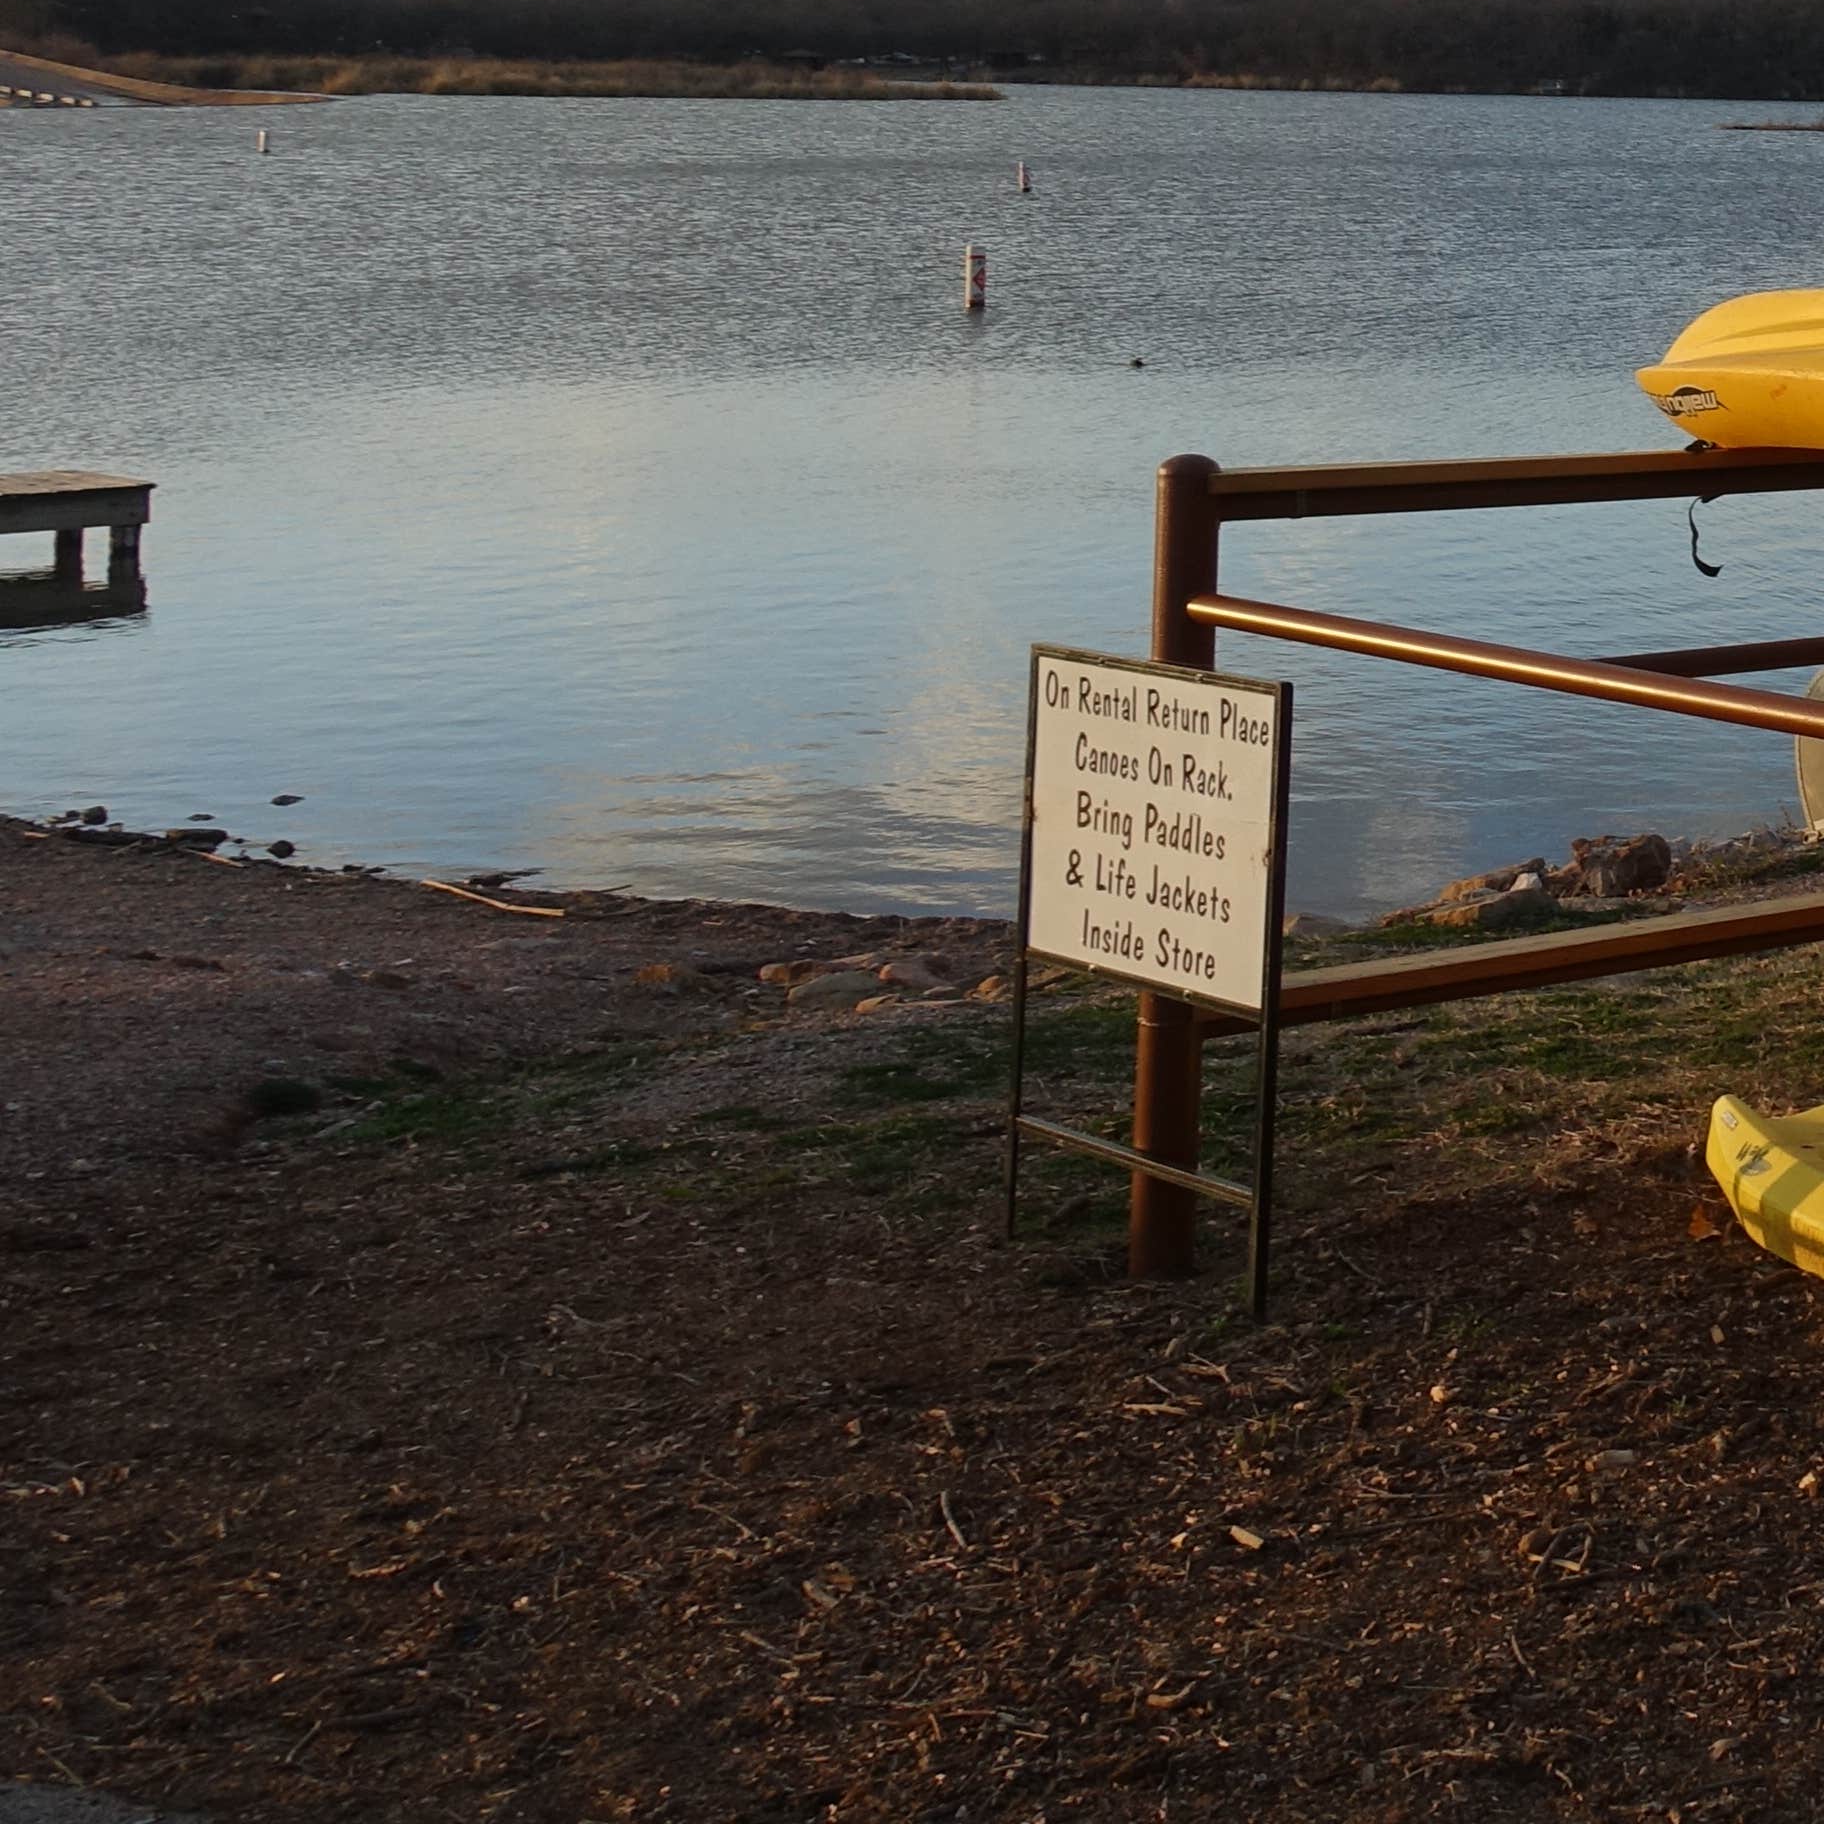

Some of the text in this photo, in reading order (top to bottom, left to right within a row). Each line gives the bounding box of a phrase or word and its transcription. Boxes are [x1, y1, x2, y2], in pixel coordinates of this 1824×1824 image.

[1045, 669, 1270, 747] On Rental Return Place
[1075, 732, 1233, 800] Canoes On Rack.
[1076, 791, 1226, 860] Bring Paddles
[1066, 849, 1231, 923] & Life Jackets
[1081, 908, 1216, 979] Inside Store
